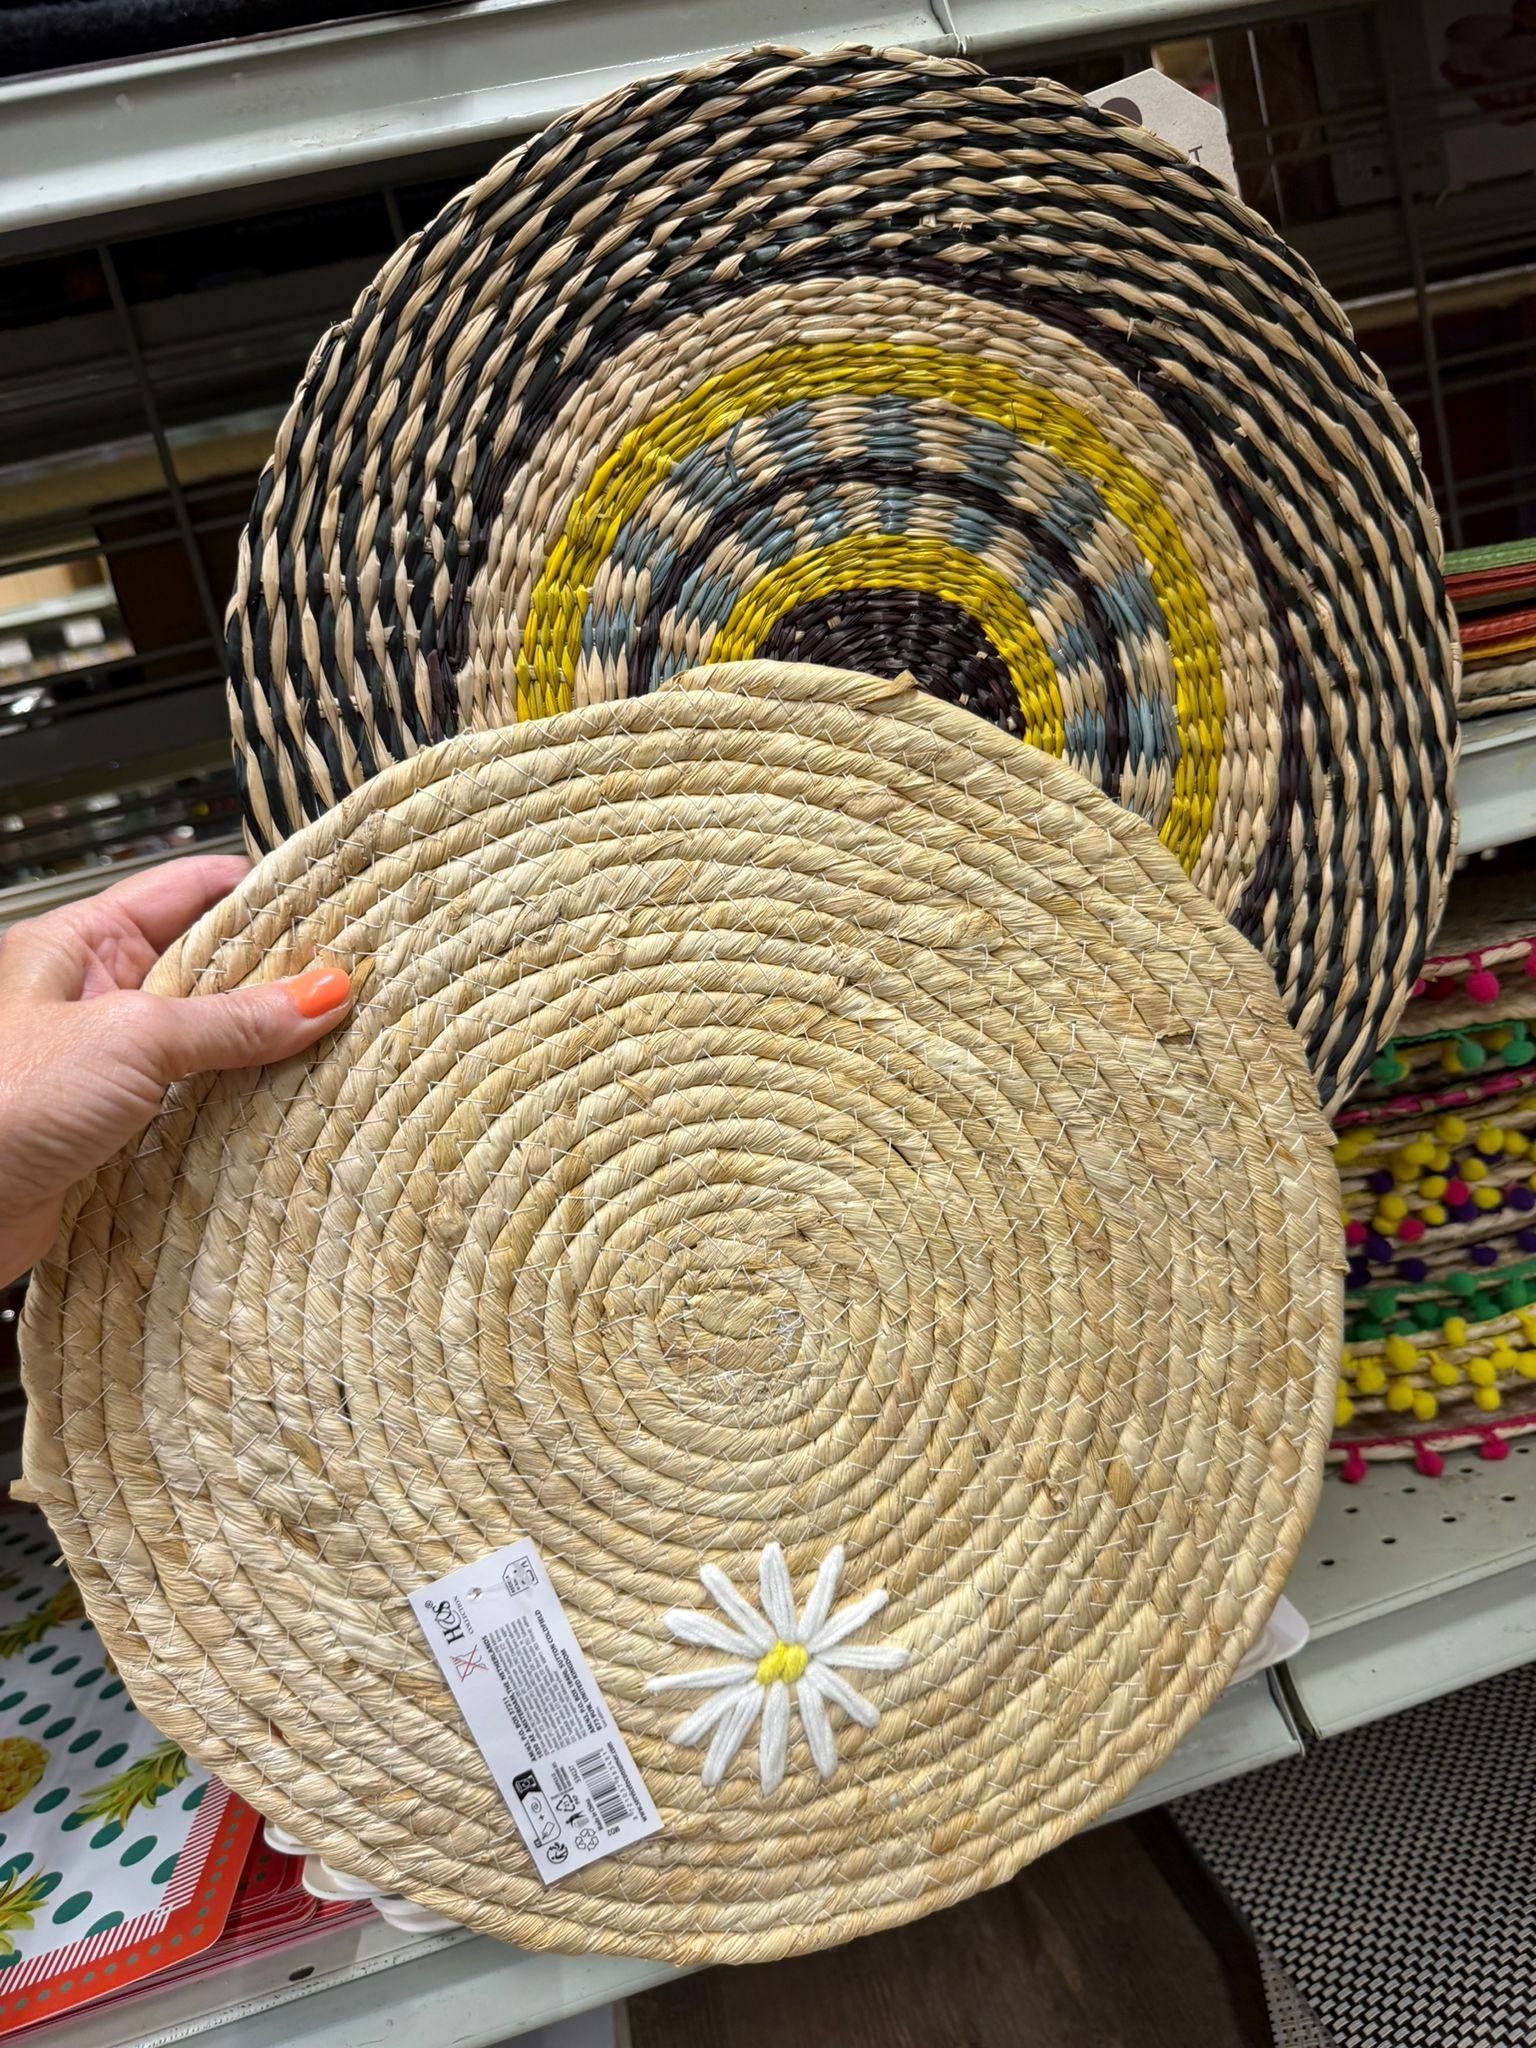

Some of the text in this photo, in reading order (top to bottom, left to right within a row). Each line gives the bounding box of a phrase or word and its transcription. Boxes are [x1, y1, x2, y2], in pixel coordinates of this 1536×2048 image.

[452, 1595, 474, 1634] COLLECTION
[533, 1609, 553, 1643] COLDFIELD
[481, 1634, 506, 1680] NETHERLANDS
[549, 1643, 564, 1668] SUTTON
[559, 1648, 578, 1679] KINGDOM
[574, 1678, 588, 1702] UNITED
[511, 1715, 521, 1728] BOX
